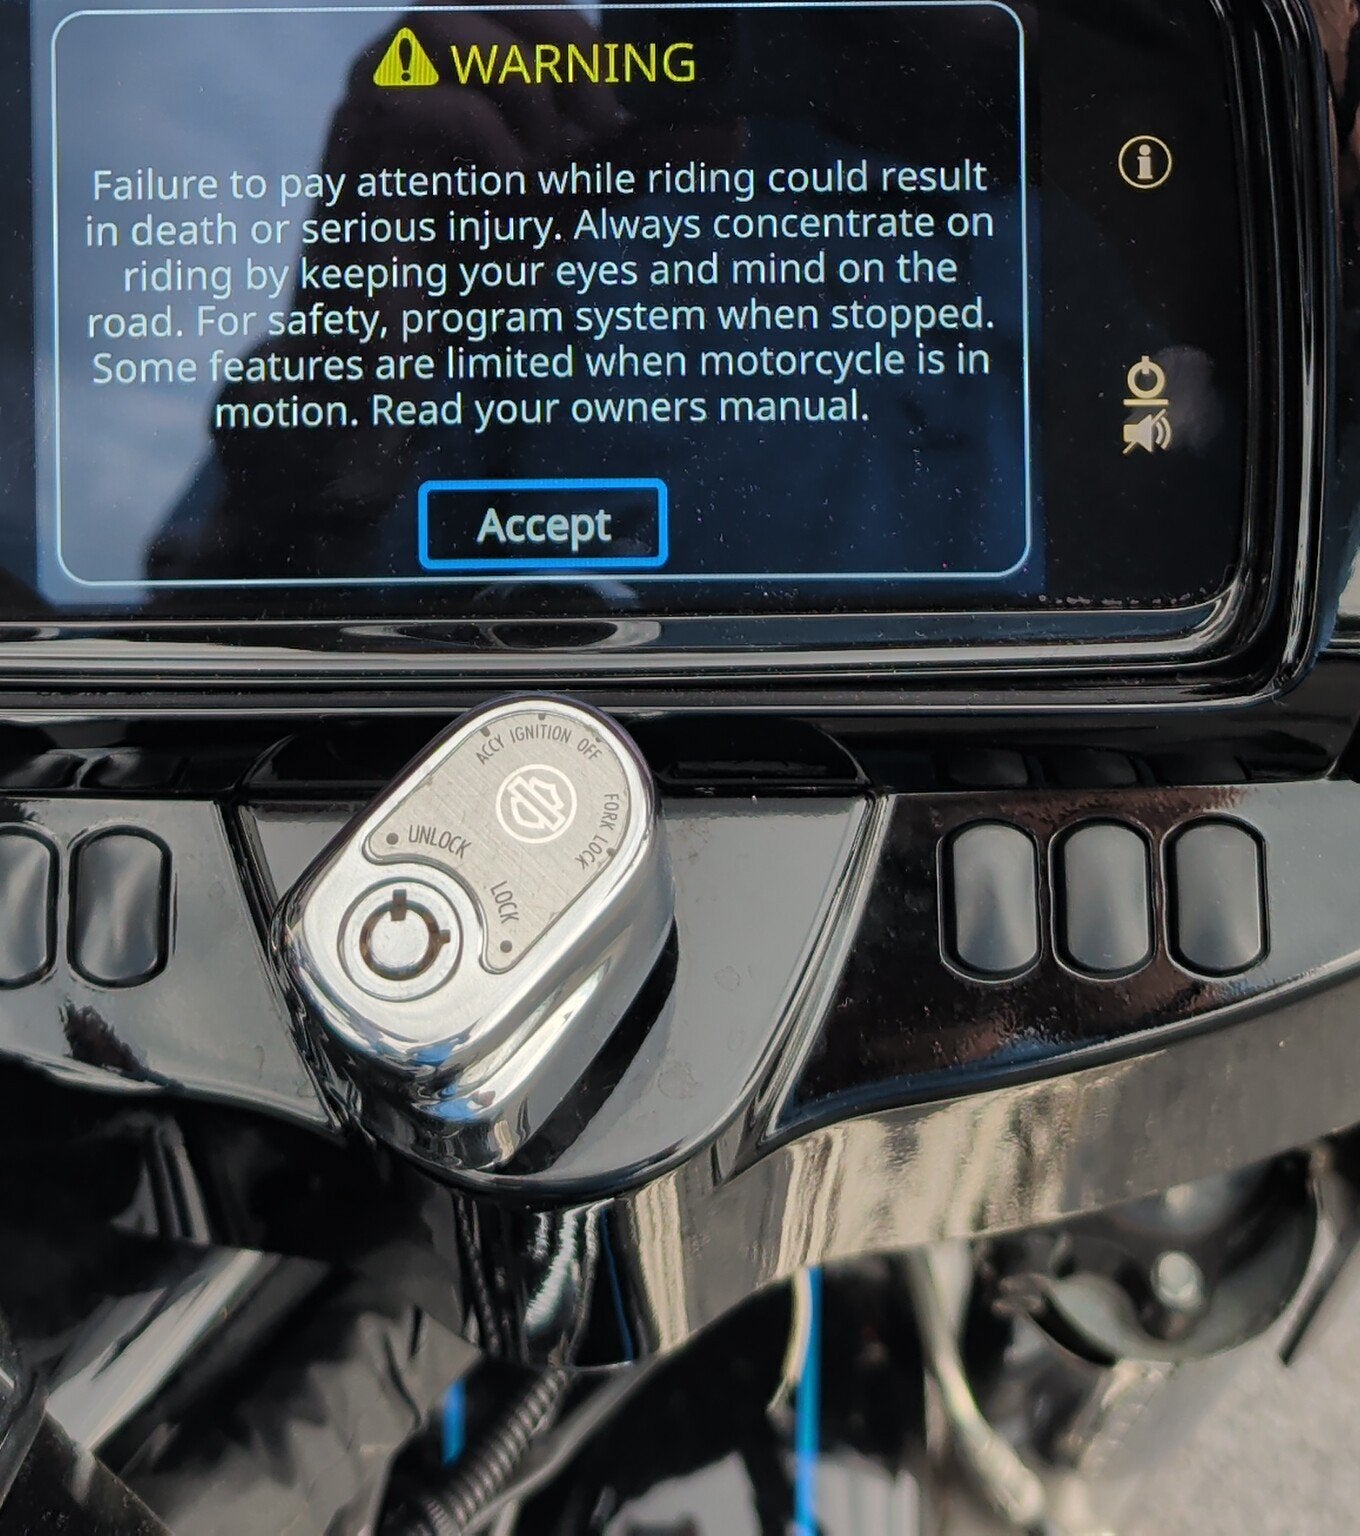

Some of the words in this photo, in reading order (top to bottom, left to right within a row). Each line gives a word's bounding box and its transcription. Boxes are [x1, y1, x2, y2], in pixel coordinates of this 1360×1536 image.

[450, 42, 696, 85] WARNING
[93, 167, 219, 201] Failure
[230, 170, 267, 200] to
[280, 171, 345, 207] pay
[357, 165, 526, 198] attention
[539, 162, 635, 194] while
[648, 161, 755, 201] riding
[768, 159, 867, 193] could
[882, 158, 987, 192] result
[86, 215, 119, 247] in
[132, 213, 237, 246] death
[251, 219, 290, 244] or
[302, 211, 437, 244] serious
[449, 210, 561, 250] injury.
[574, 207, 701, 248] Always
[713, 210, 934, 239] concentrate
[947, 211, 994, 238] on
[124, 259, 232, 299] riding
[247, 257, 289, 298] by
[301, 256, 447, 296] keeping
[459, 262, 545, 296] your
[556, 261, 638, 294] eyes
[650, 252, 719, 286] and
[732, 251, 825, 285] mind
[839, 256, 884, 283] on
[897, 250, 958, 283] the
[88, 306, 183, 338] road.
[197, 305, 256, 336] For
[268, 302, 388, 343] safety,
[402, 305, 562, 341] program
[575, 302, 706, 340] system
[717, 297, 819, 330] when
[831, 296, 995, 338] stopped.
[92, 352, 197, 384] Some
[210, 349, 363, 383] features
[375, 354, 434, 381] are
[447, 346, 573, 379] limited
[585, 345, 687, 378] when
[701, 342, 905, 384] motorcycle
[918, 342, 944, 374] is
[957, 342, 990, 374] in
[215, 395, 359, 428] motion.
[373, 392, 462, 426] Read
[473, 398, 560, 434] your
[571, 396, 707, 423] owners
[719, 388, 869, 422] manual.
[475, 507, 613, 552] Accept
[475, 734, 505, 765] ACCY
[509, 723, 572, 744] IGNITION
[577, 737, 603, 760] OFF
[600, 793, 619, 831] FORK
[408, 824, 472, 859] UNLOCK
[574, 834, 608, 870] LOCK
[490, 880, 520, 924] LOCK
